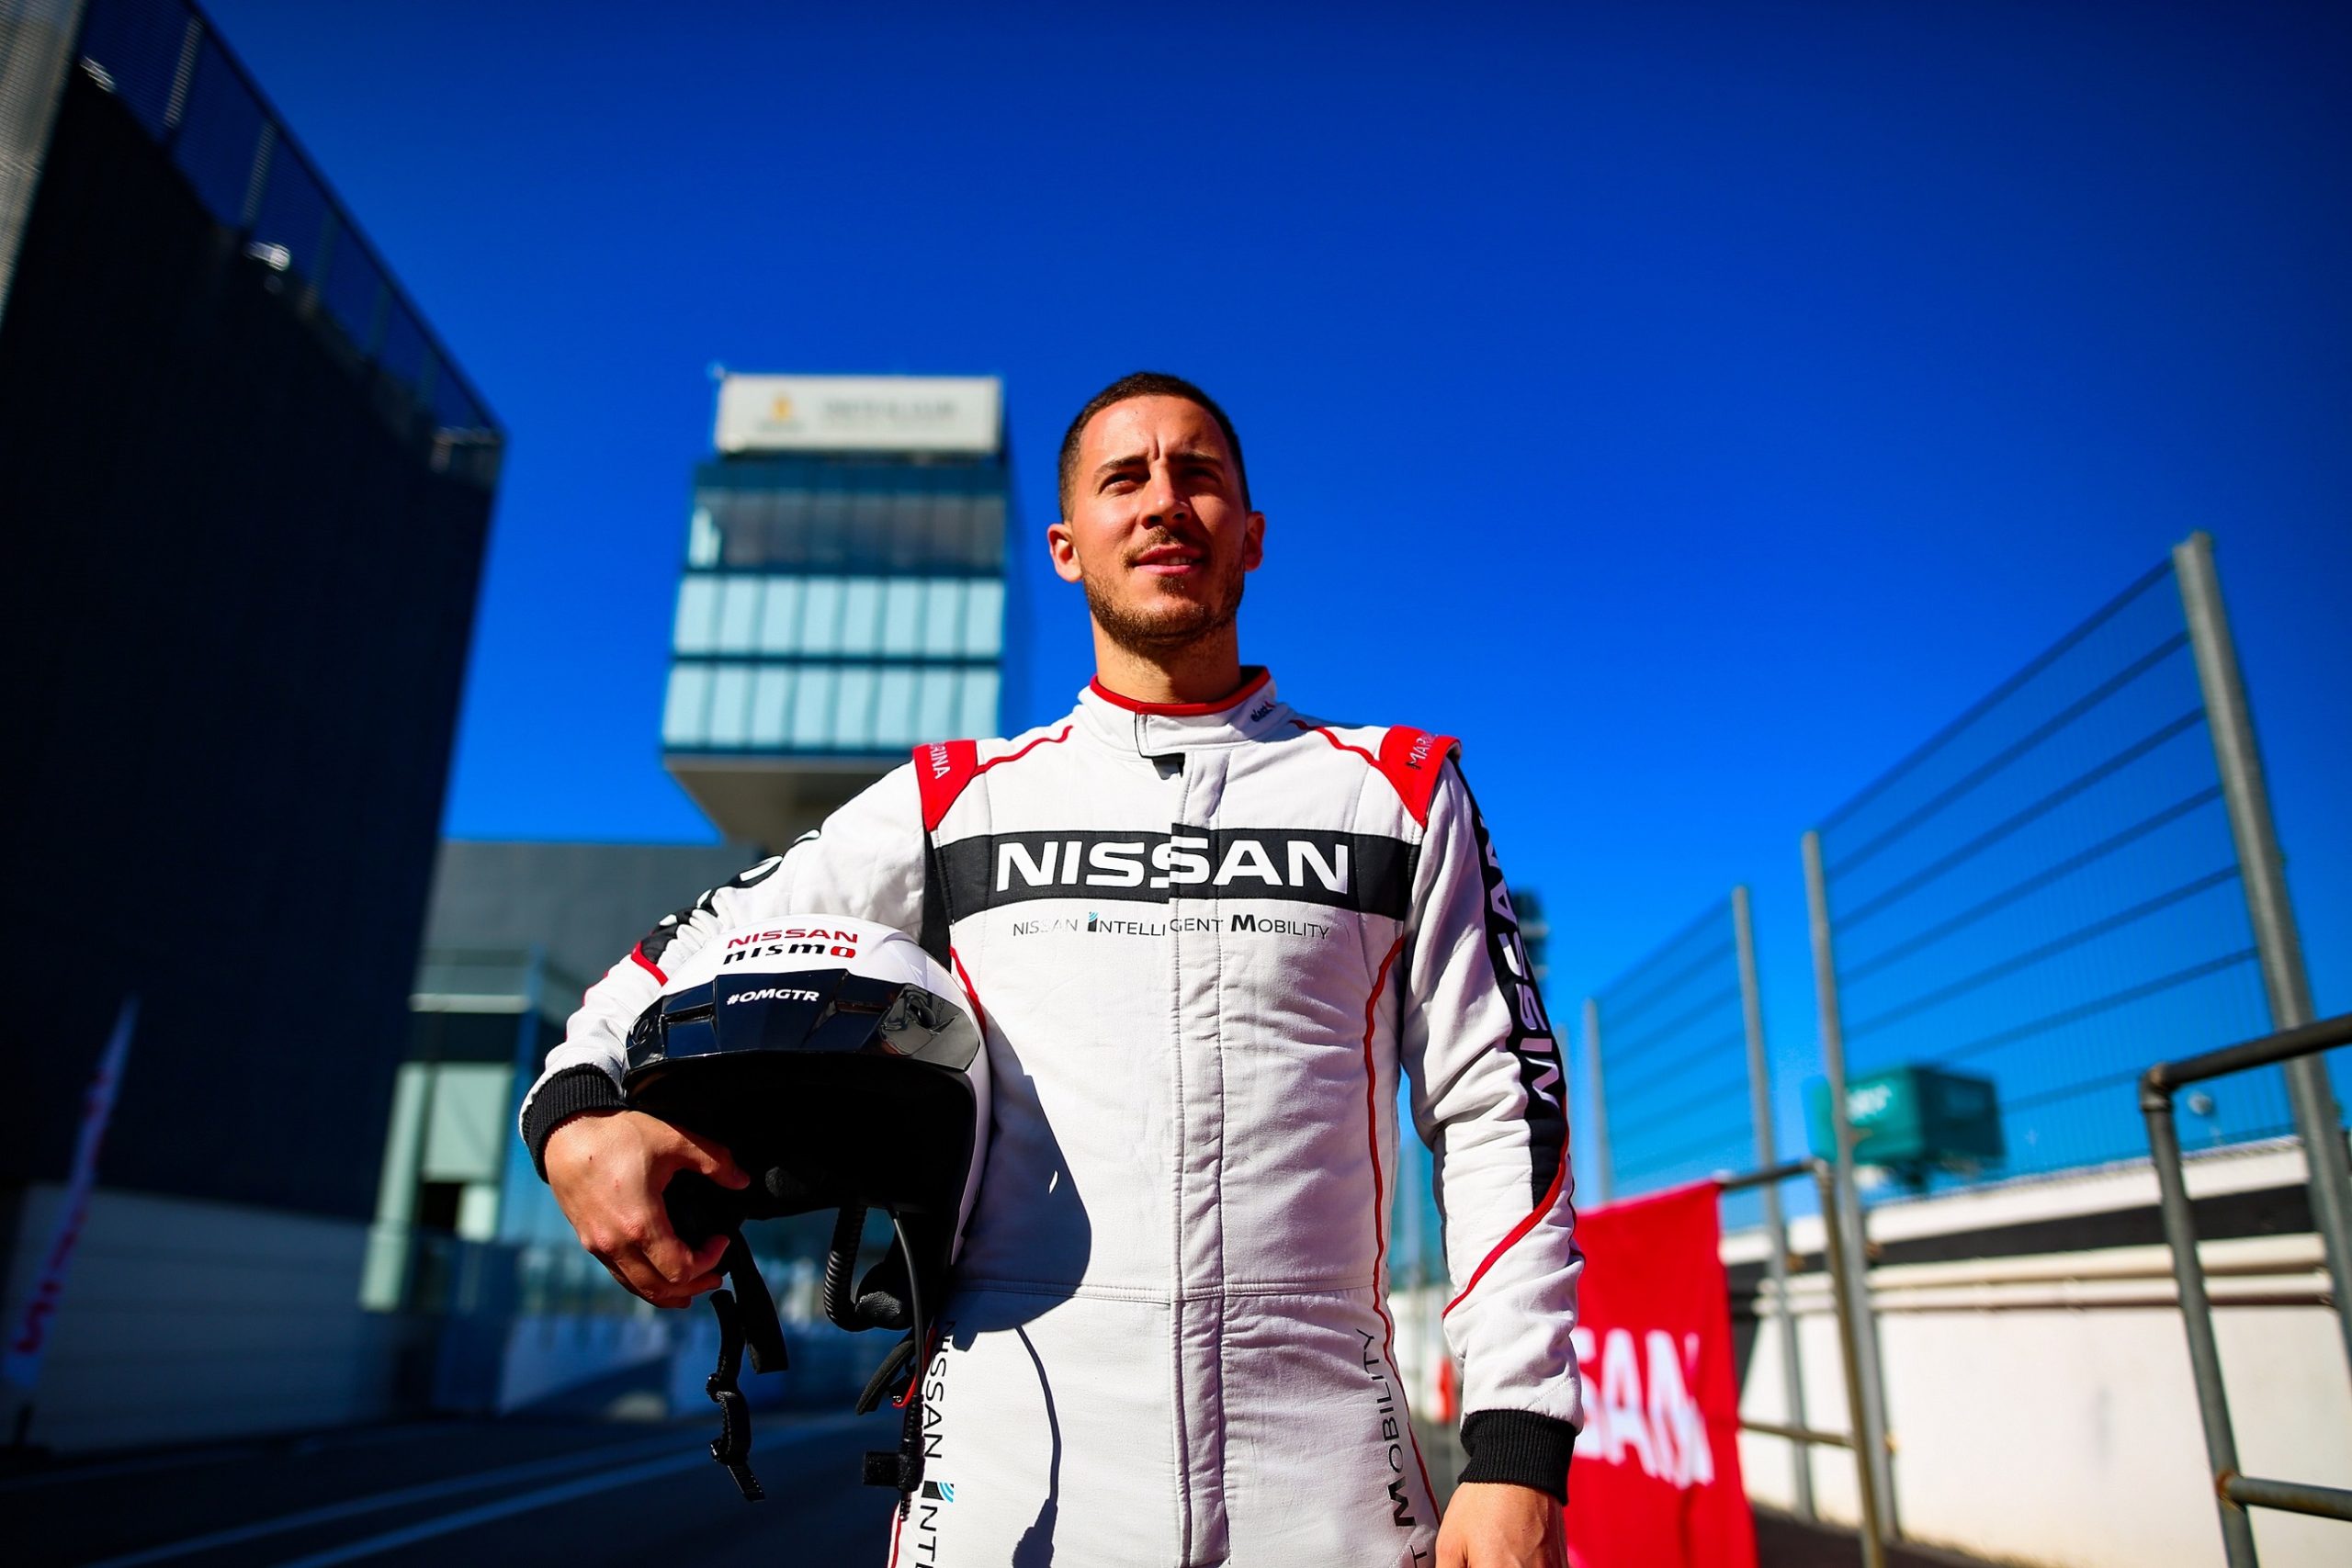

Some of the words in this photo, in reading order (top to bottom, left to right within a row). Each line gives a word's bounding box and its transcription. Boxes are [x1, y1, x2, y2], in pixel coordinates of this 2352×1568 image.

[930, 742, 951, 779] RINA
[996, 835, 1349, 895] NISSAN
[727, 929, 858, 949] NISSAN
[1088, 911, 1223, 936] INTELLIGENT
[1230, 914, 1329, 940] MOBILITY
[726, 987, 820, 1006] #OMGTR
[1355, 1327, 1417, 1528] MOBILITY
